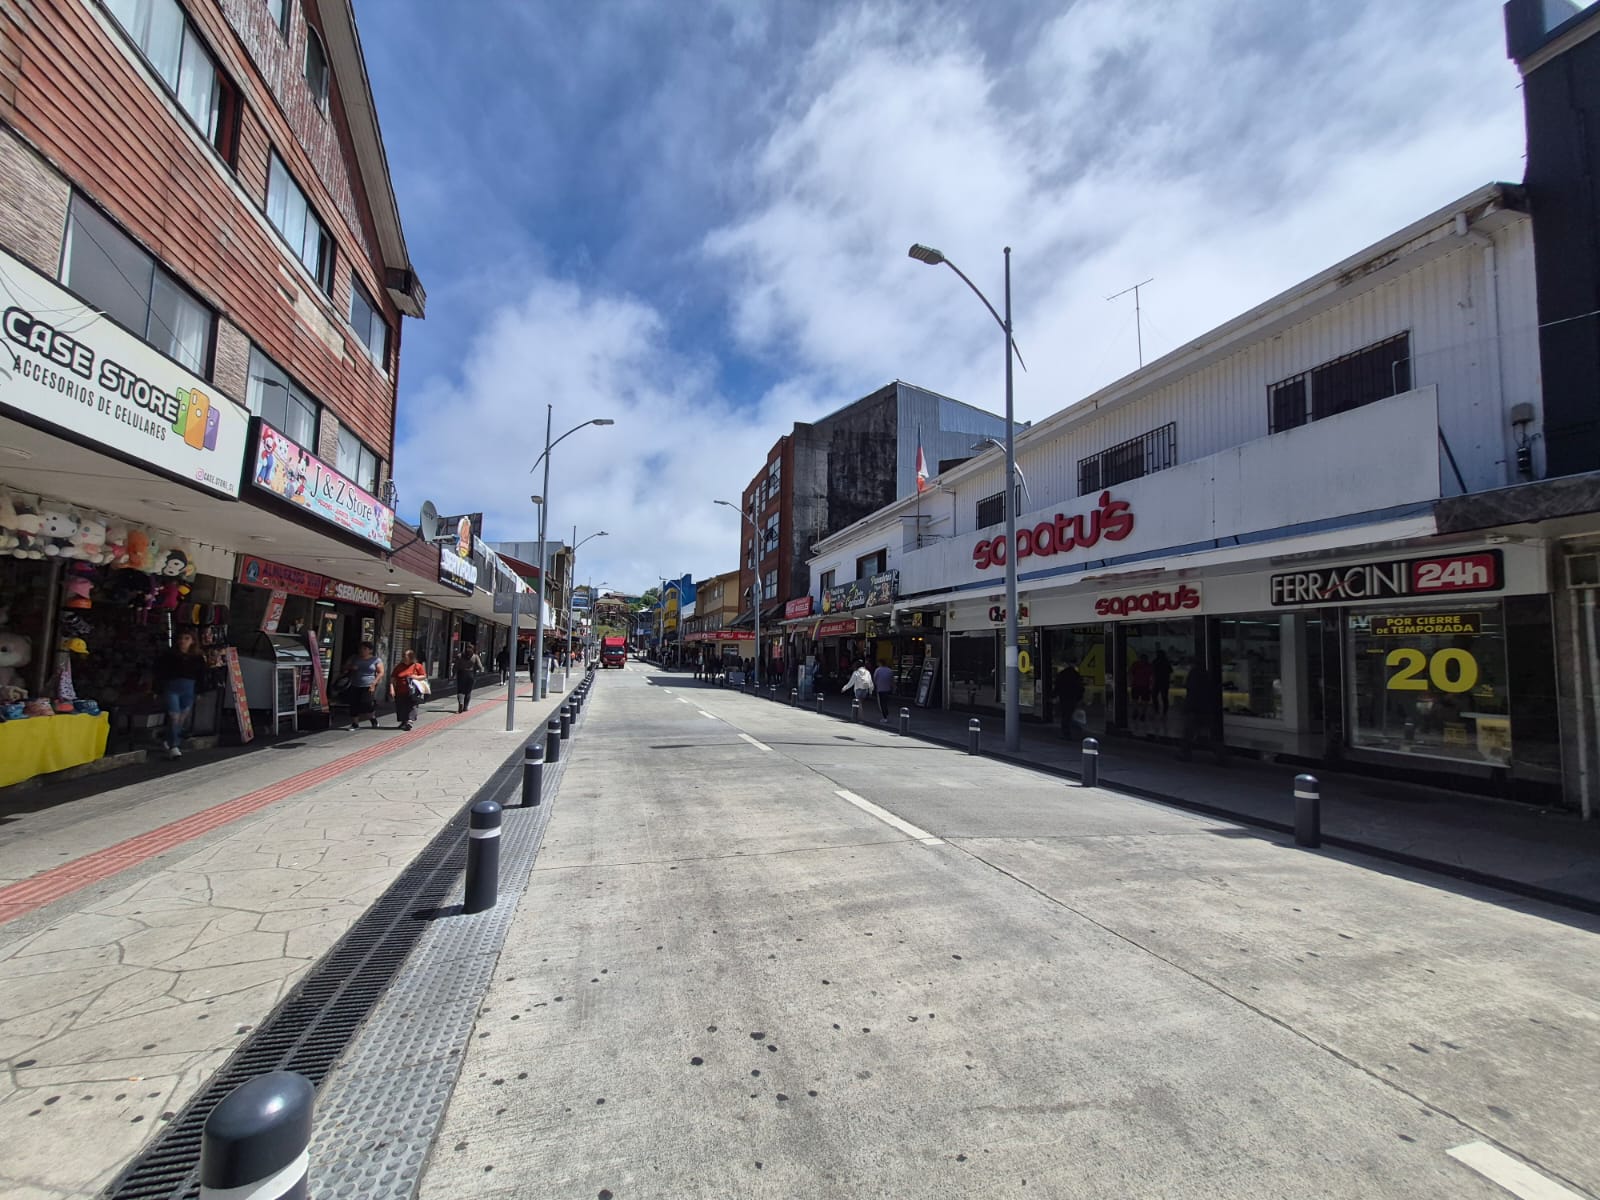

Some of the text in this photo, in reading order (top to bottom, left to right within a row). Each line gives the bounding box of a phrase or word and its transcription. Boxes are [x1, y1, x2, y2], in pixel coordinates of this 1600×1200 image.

[3, 306, 181, 424] CASE STORE
[13, 355, 167, 441] ACCESORIOS DE CELULARES
[310, 465, 321, 498] J
[322, 474, 334, 499] &
[335, 480, 346, 506] Z
[346, 487, 372, 521] Store
[1094, 584, 1201, 616] sapatu's
[1271, 561, 1488, 603] FERRACINI 24h
[1376, 623, 1474, 635] DE TEMPORADA
[1386, 615, 1462, 626] POR CIERRE
[1385, 647, 1479, 693] 20
